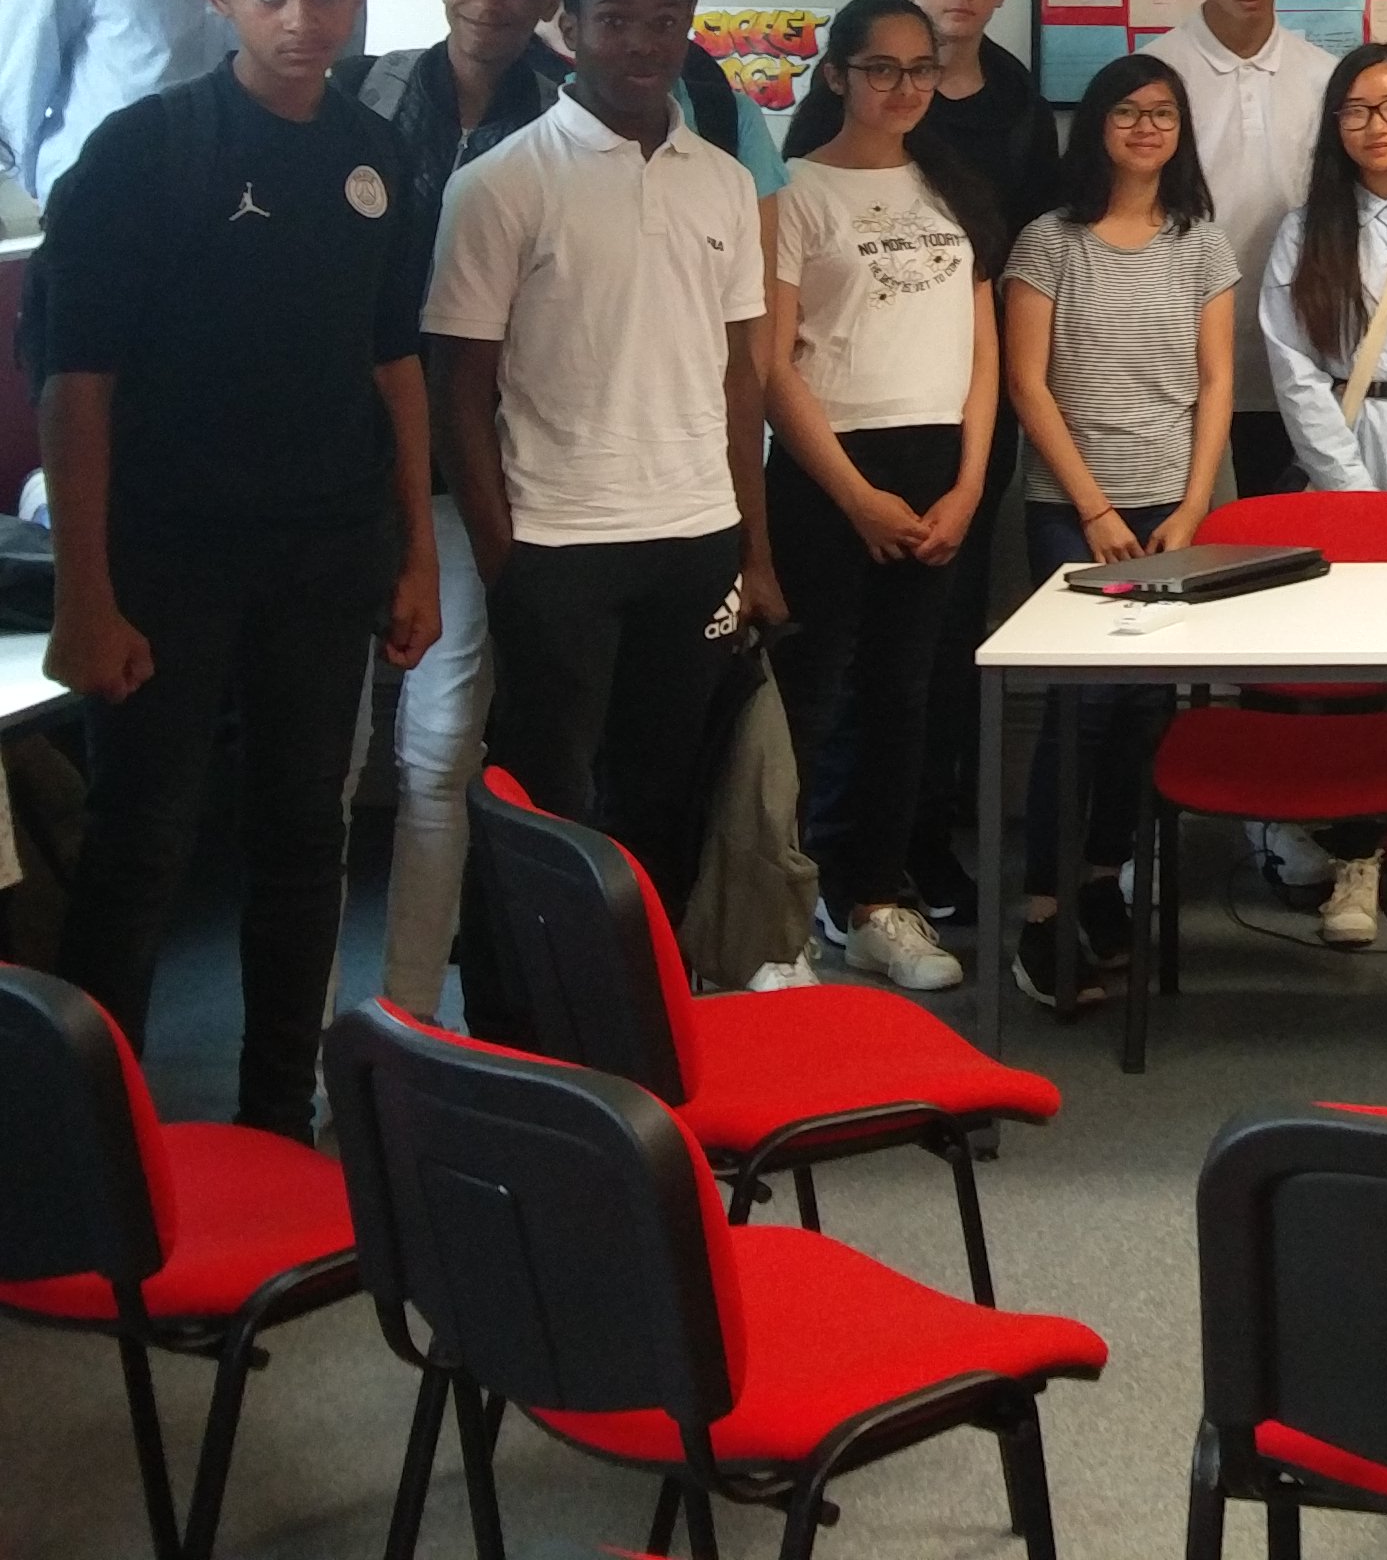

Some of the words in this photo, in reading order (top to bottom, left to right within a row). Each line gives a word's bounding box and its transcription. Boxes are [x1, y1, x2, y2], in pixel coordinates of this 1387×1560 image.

[857, 241, 878, 256] NO
[881, 238, 915, 252] MORE
[920, 233, 961, 247] TODAY
[934, 274, 945, 284] TO
[704, 612, 738, 640] adi
